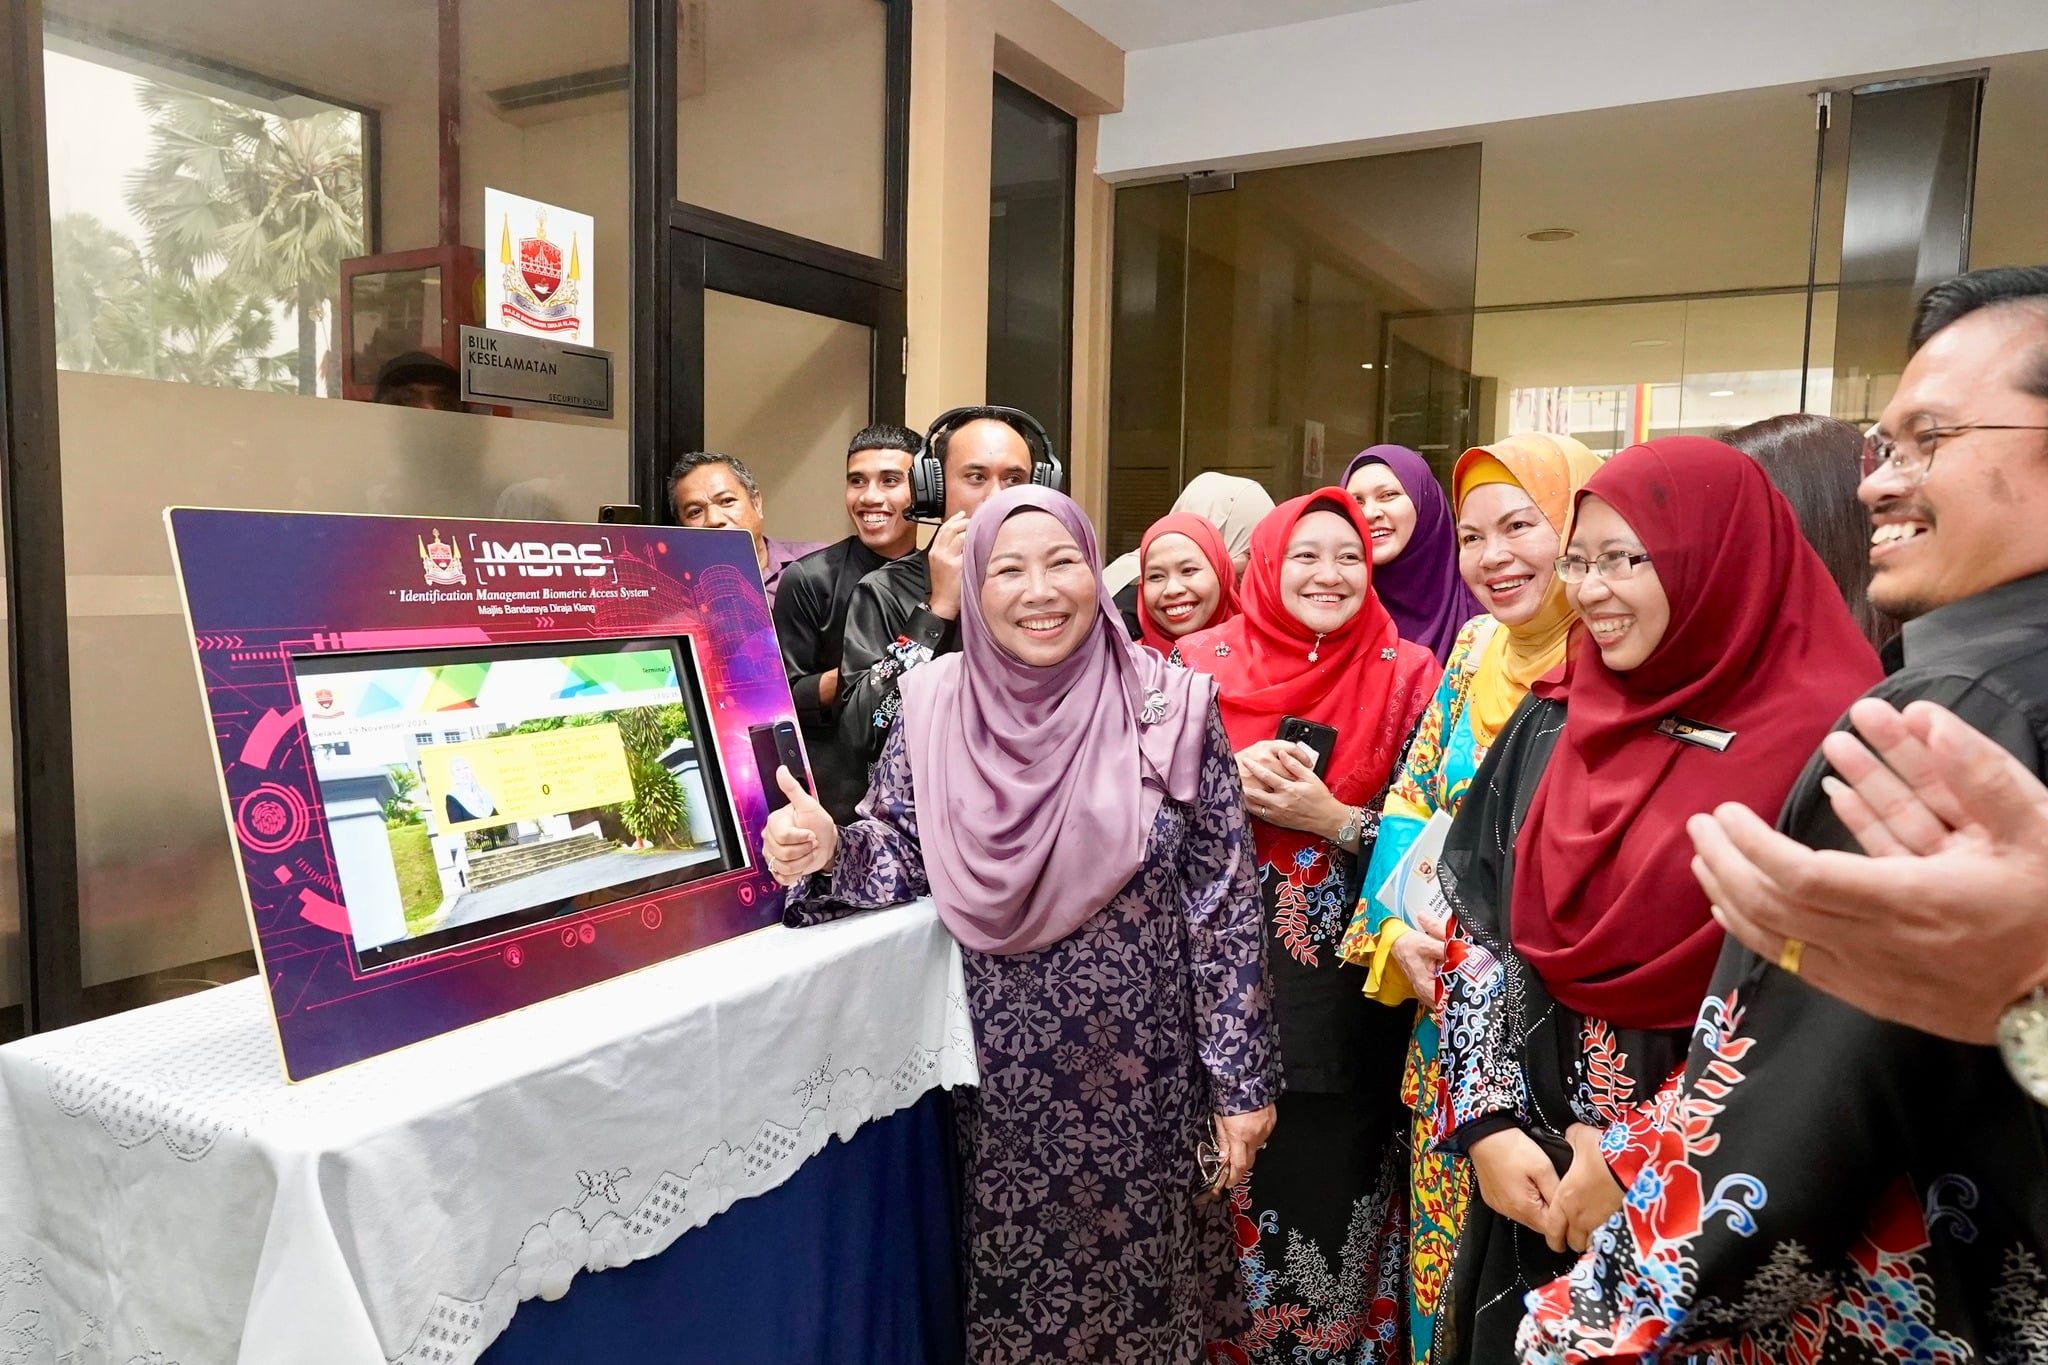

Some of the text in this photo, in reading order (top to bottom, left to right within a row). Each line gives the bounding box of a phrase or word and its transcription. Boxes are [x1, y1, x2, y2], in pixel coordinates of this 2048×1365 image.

[468, 335, 498, 352] BILIK
[468, 350, 557, 375] KESELAMATAN
[549, 393, 580, 404] SECURITY
[400, 588, 473, 604] Identification
[476, 588, 540, 602] Management
[542, 587, 588, 600] Biometric
[589, 587, 618, 599] Access
[620, 586, 649, 600] System
[477, 602, 596, 616] Majlis Bandaraya Diraja Klang
